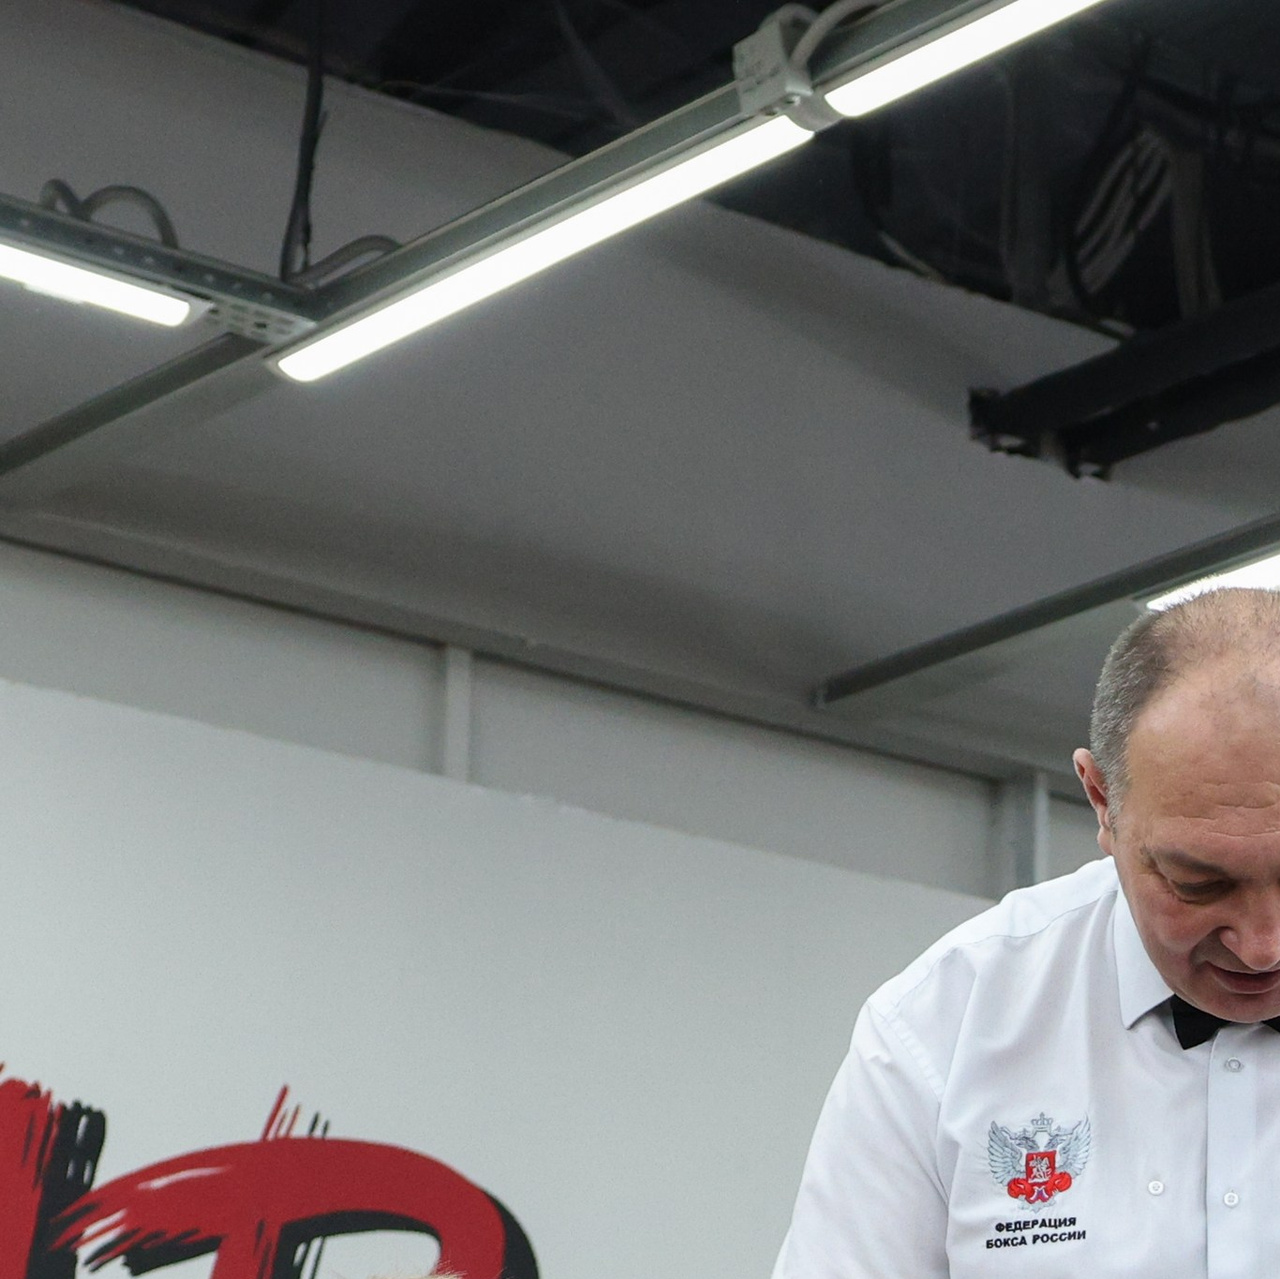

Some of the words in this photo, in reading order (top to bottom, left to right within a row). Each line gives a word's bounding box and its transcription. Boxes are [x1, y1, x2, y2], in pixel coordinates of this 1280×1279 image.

[995, 1217, 1077, 1233] ФЕДЕРАЦИЯ
[986, 1236, 1027, 1249] БОКСА
[1032, 1230, 1086, 1245] РОССИИ
